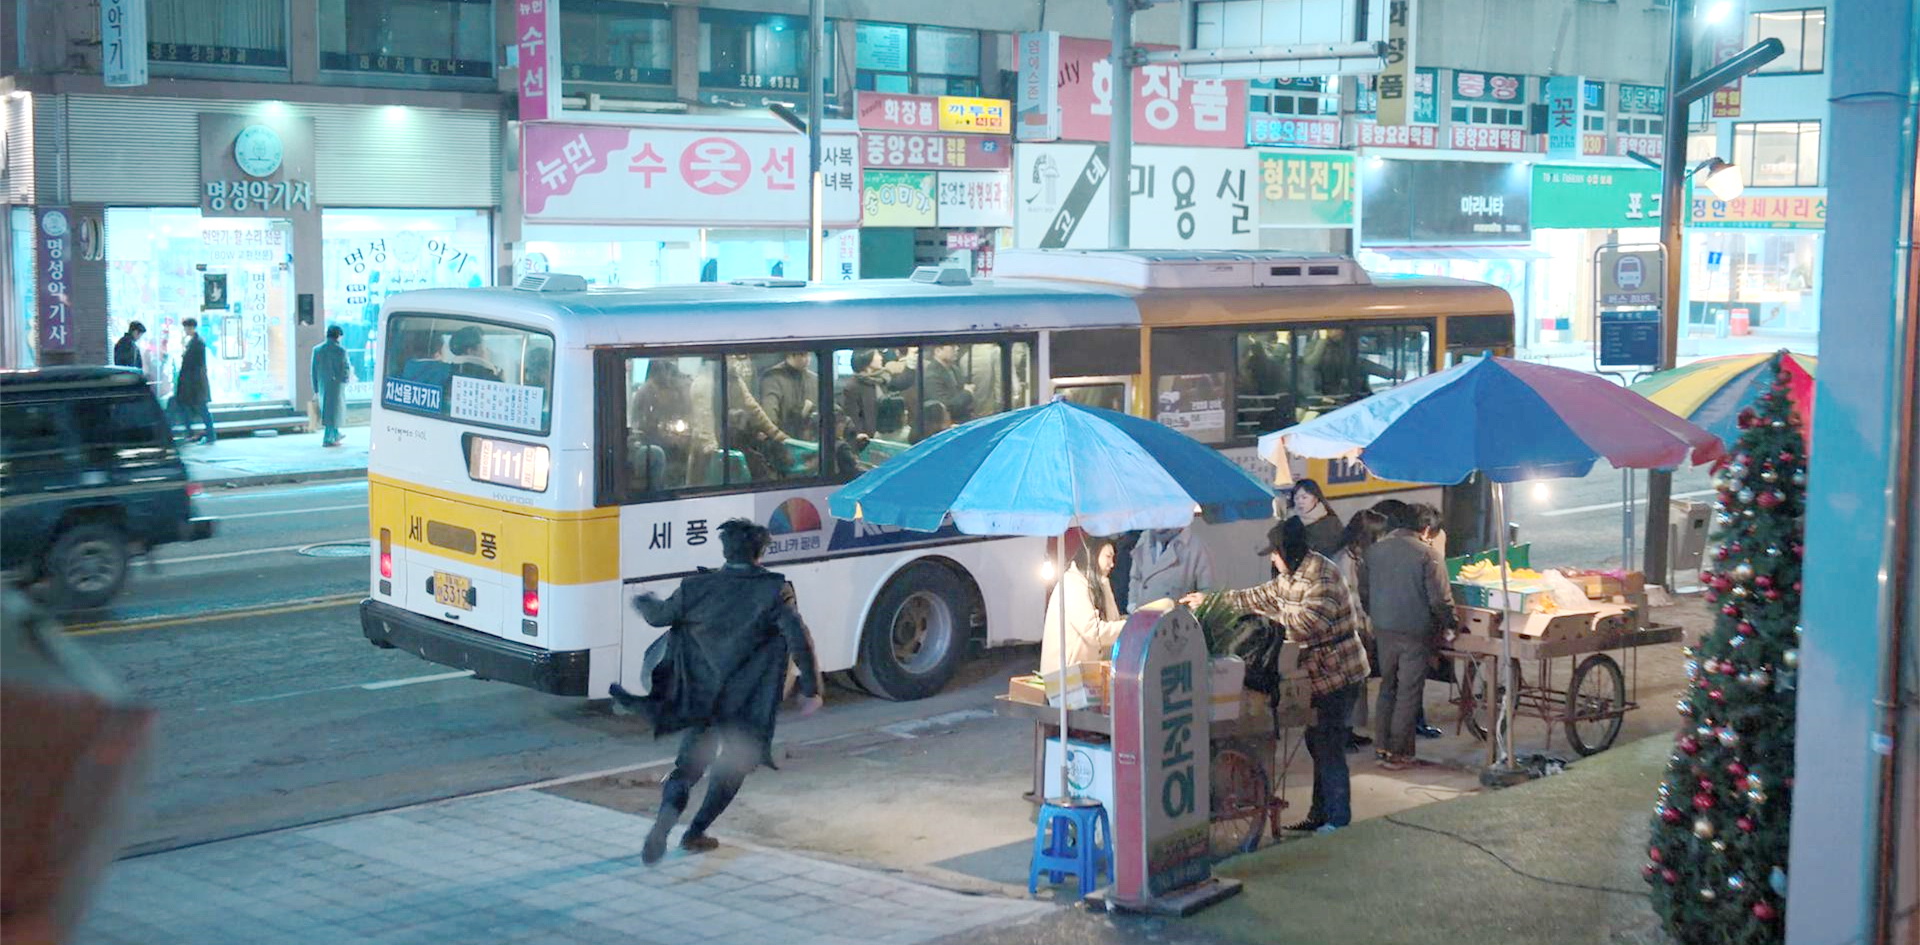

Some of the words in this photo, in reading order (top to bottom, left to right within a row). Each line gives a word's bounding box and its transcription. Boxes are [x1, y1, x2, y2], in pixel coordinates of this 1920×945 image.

[107, 0, 124, 70] 악기
[521, 26, 544, 97] 수선
[1057, 60, 1080, 88] uty
[1091, 59, 1229, 131] 화장품
[1457, 73, 1519, 100] 중앙
[884, 98, 933, 126] 화장품
[949, 104, 1003, 117] 까투리
[1552, 98, 1575, 128] 꽃
[1255, 119, 1335, 142] 중앙요리학원
[1361, 125, 1434, 146] 중앙요리학원
[1455, 127, 1522, 149] 중앙요리학원
[536, 132, 596, 190] 뉴먼
[824, 147, 853, 166] 사복
[867, 134, 944, 166] 중앙요리
[1619, 138, 1663, 156] 중앙요리
[824, 172, 853, 191] 녀복
[1263, 158, 1350, 201] 형진전기
[206, 181, 313, 212] 명성악기사
[1460, 195, 1504, 217] 마리나타
[46, 238, 68, 346] 명성악기사
[252, 272, 268, 372] 명성악기사
[492, 449, 523, 480] 111
